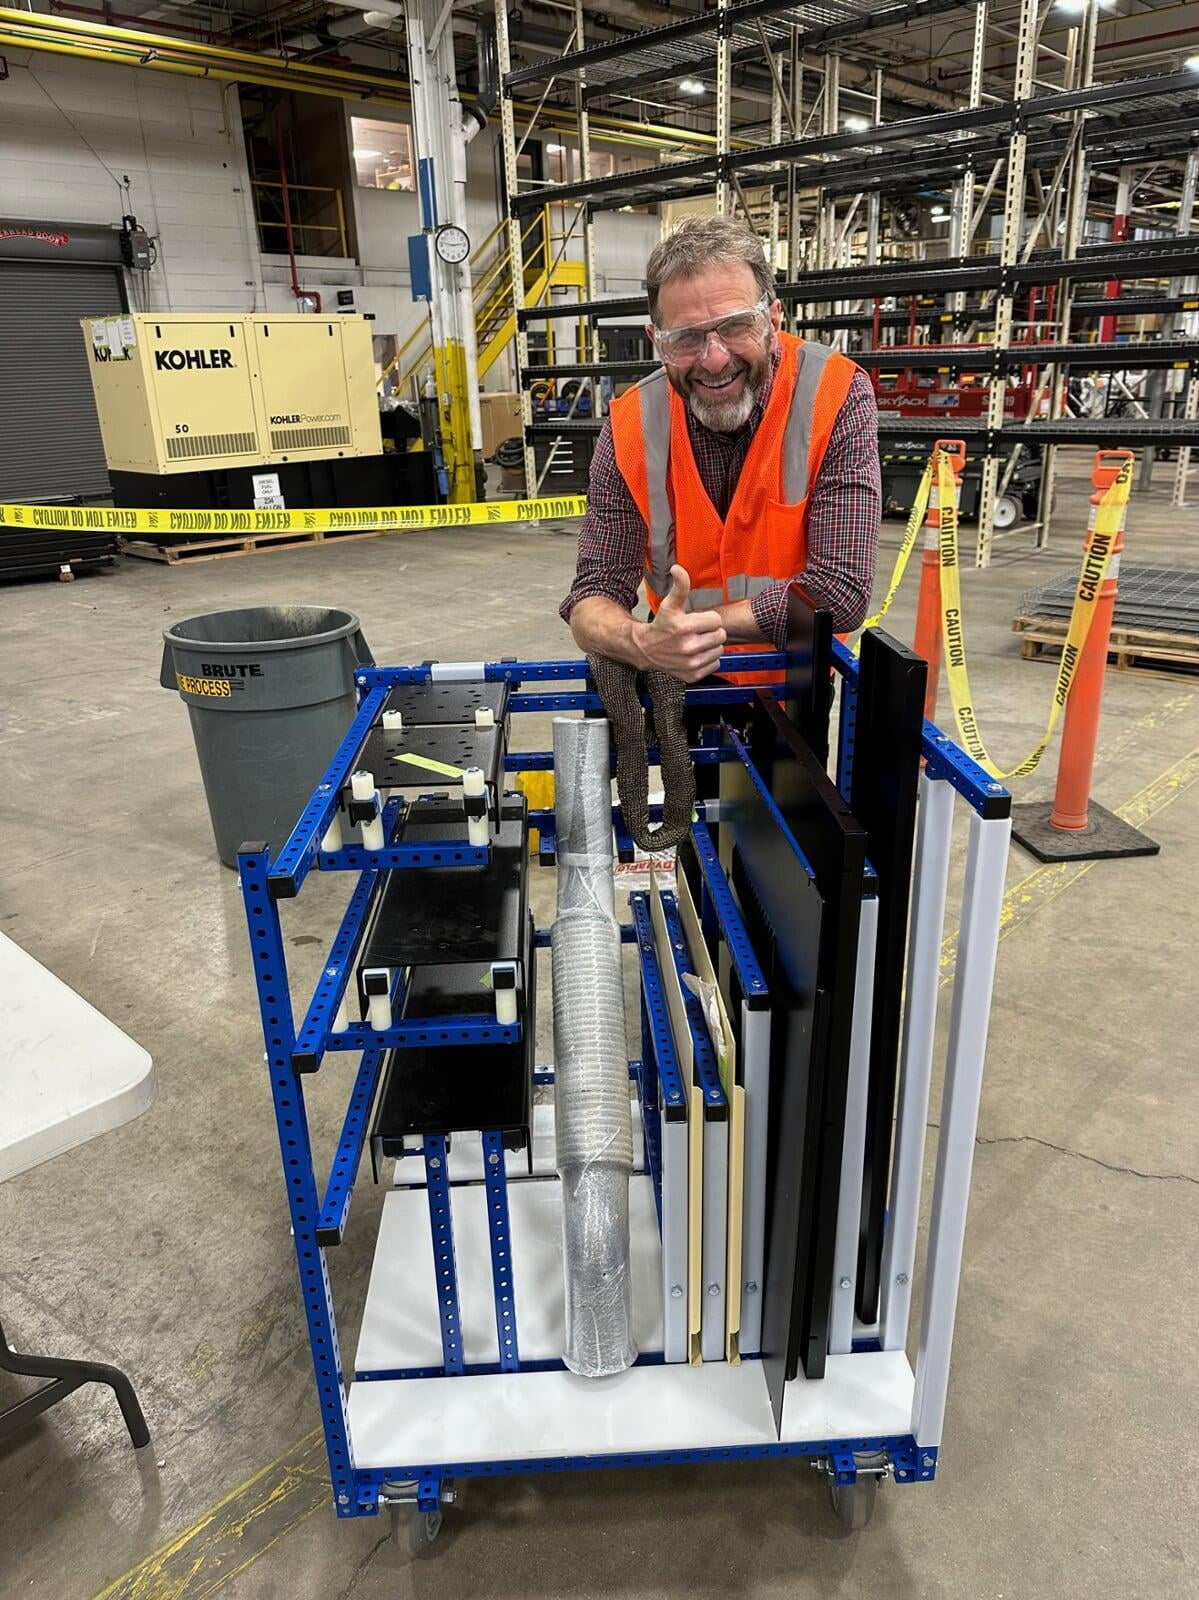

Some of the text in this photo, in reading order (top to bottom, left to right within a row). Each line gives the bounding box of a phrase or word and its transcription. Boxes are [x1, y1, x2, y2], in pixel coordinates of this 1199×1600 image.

[155, 349, 234, 370] KOHLER
[877, 395, 926, 407] SKYJACK
[175, 424, 189, 434] 50
[894, 441, 926, 450] SKYJACK
[942, 506, 956, 567] CAUTION
[1079, 533, 1112, 602] CAUTION
[945, 608, 964, 667] CAUTION
[201, 663, 261, 677] BRUTE
[1055, 643, 1079, 706] CAUTION
[186, 678, 230, 697] PROCESS
[958, 706, 987, 761] CAUTION
